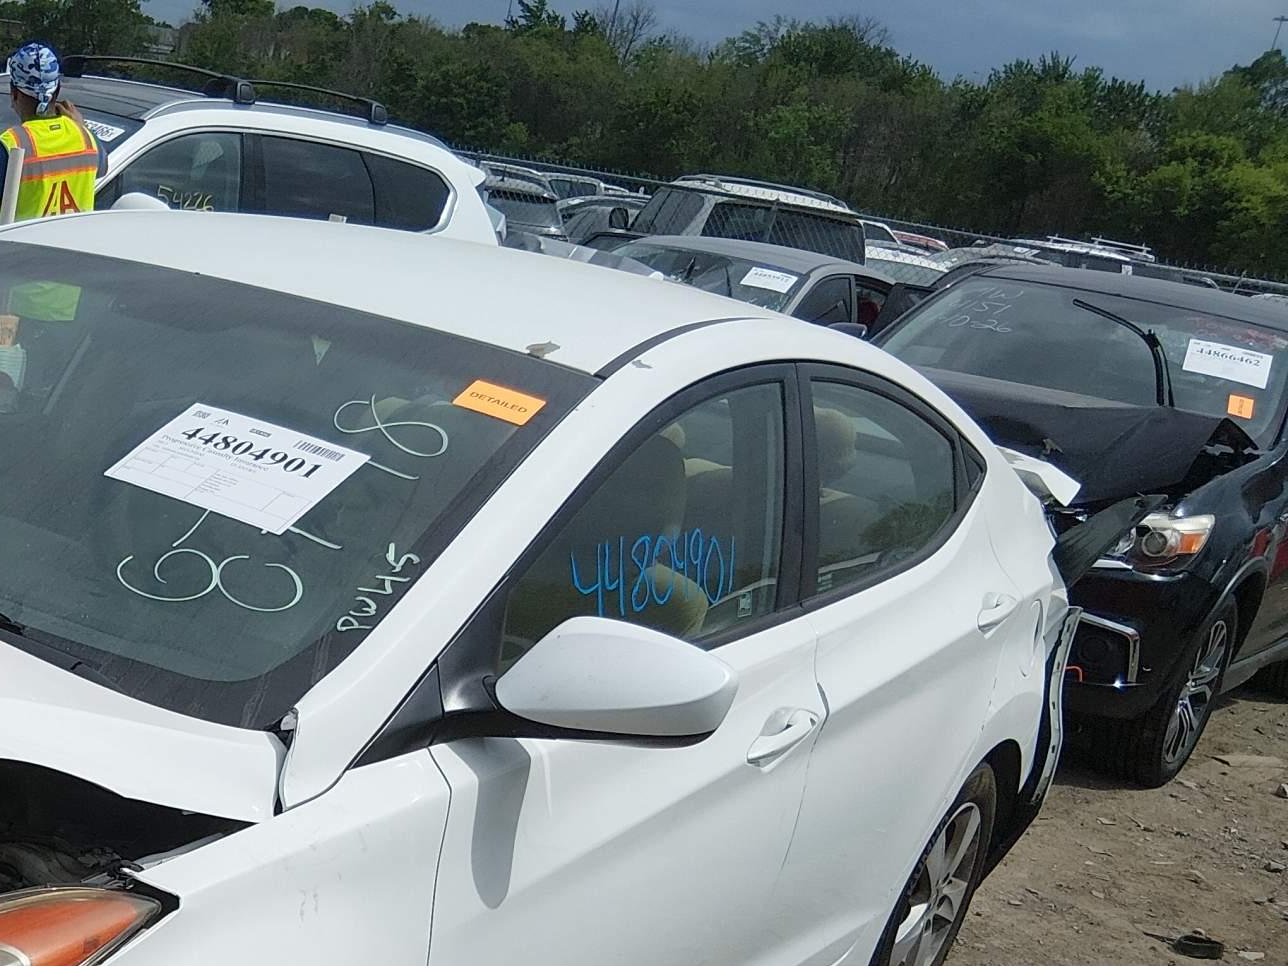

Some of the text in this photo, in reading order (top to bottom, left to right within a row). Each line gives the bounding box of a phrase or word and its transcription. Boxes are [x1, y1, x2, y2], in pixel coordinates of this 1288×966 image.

[469, 390, 528, 414] DETAILED
[180, 426, 323, 479] 44804901
[569, 527, 735, 618] 44804901
